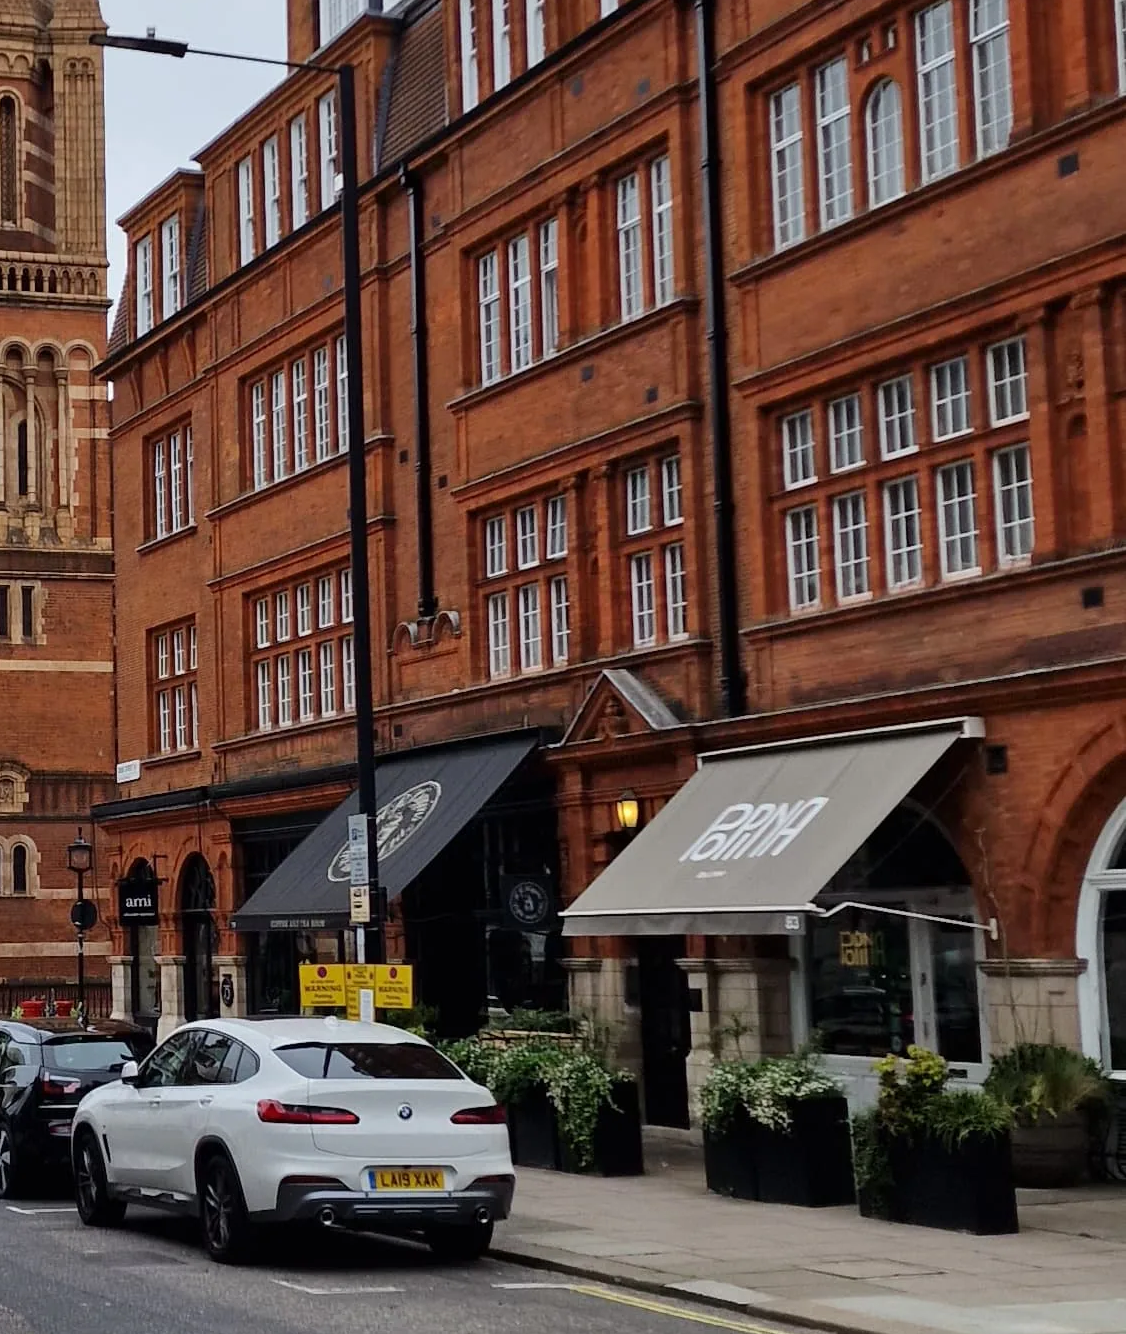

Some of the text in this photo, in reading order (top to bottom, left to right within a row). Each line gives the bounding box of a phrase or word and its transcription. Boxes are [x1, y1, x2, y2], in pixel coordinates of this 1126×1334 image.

[125, 894, 152, 908] ami
[380, 1171, 441, 1188] LA19 XAK
